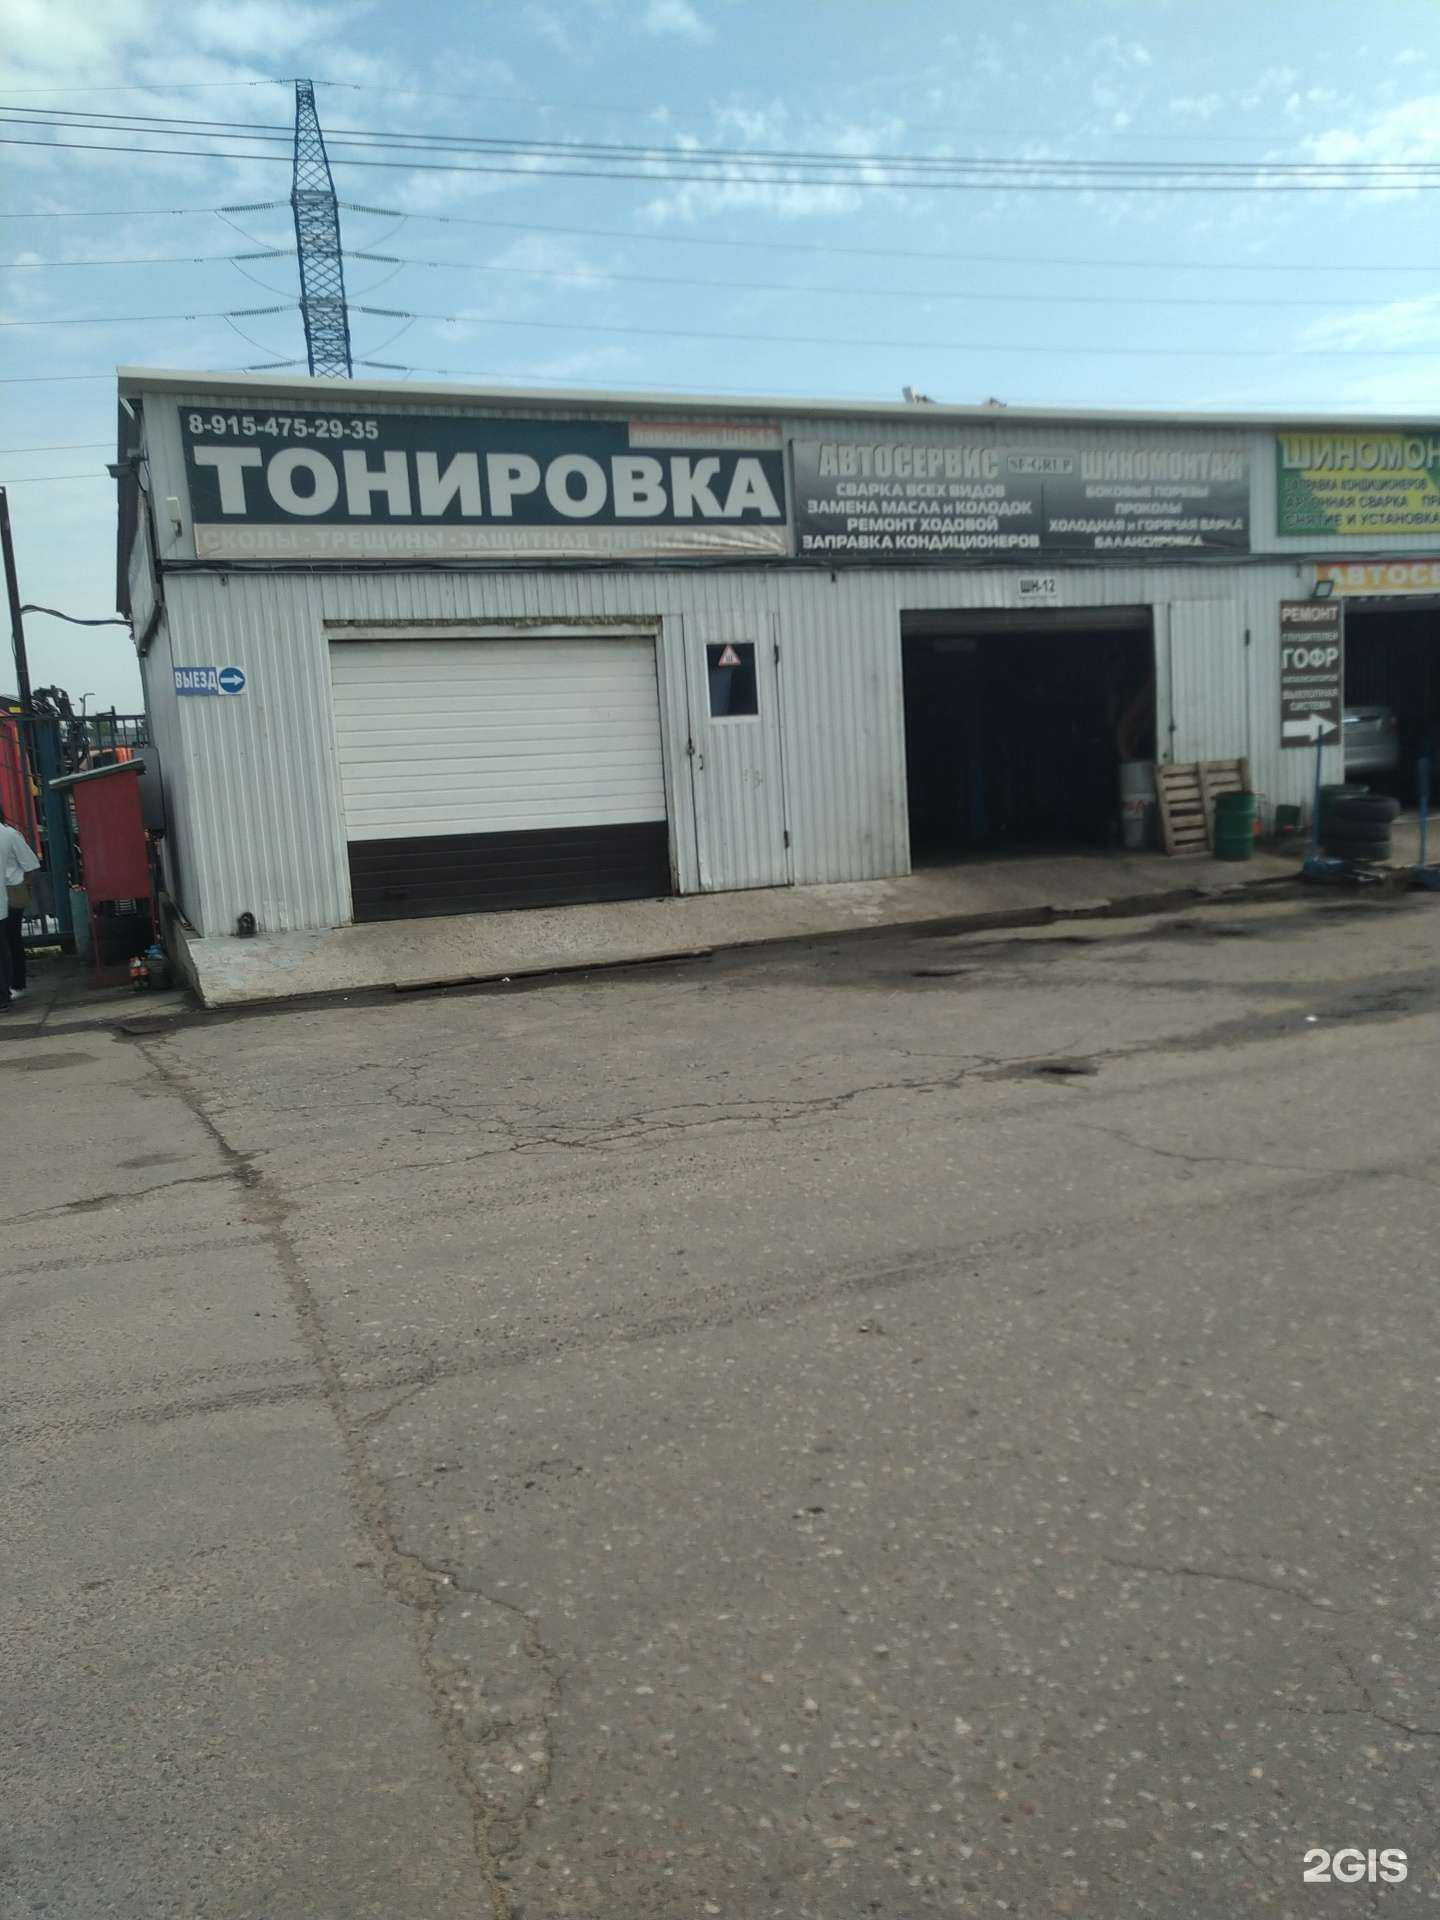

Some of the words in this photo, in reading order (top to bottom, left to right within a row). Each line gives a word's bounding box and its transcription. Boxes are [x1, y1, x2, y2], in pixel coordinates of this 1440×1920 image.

[188, 414, 379, 440] 8-915-475-29-35
[819, 445, 1000, 479] АВТОСЕРВИС
[1282, 437, 1440, 470] ШИНОМОН
[1081, 450, 1243, 480] ШИНОМОНТАЖ
[193, 446, 781, 518] ТОНИРОВКА
[836, 482, 903, 498] СВАРКА
[906, 483, 947, 498] ВСЕХ
[949, 483, 1005, 499] ВИДОВ
[808, 500, 878, 514] ЗАМЕНА
[881, 501, 940, 514] МАСЛА
[955, 501, 1032, 516] КОЛОДОК
[1115, 502, 1183, 514] ПРОКОЛЫ
[1359, 495, 1408, 508] СВАРКА
[847, 517, 915, 532] РЕМОНТ
[919, 516, 998, 533] ХОДОВОЙ
[1049, 518, 1126, 532] ХОЛОДНАЯ
[318, 531, 443, 551] ТРЕЩИНЫ
[461, 531, 589, 550] ЗАЩИТНАЯ
[803, 534, 893, 549] ЗАПРАВКА
[895, 534, 1040, 550] КОНДИЦИОНЕРОВ
[1094, 535, 1203, 549] БАЛАНСИРОВКА
[1021, 579, 1055, 593] ШН-12
[1282, 607, 1338, 622] РЕМОНТ
[1282, 648, 1338, 669] ГОФР
[175, 671, 218, 690] ВЫЕЗД
